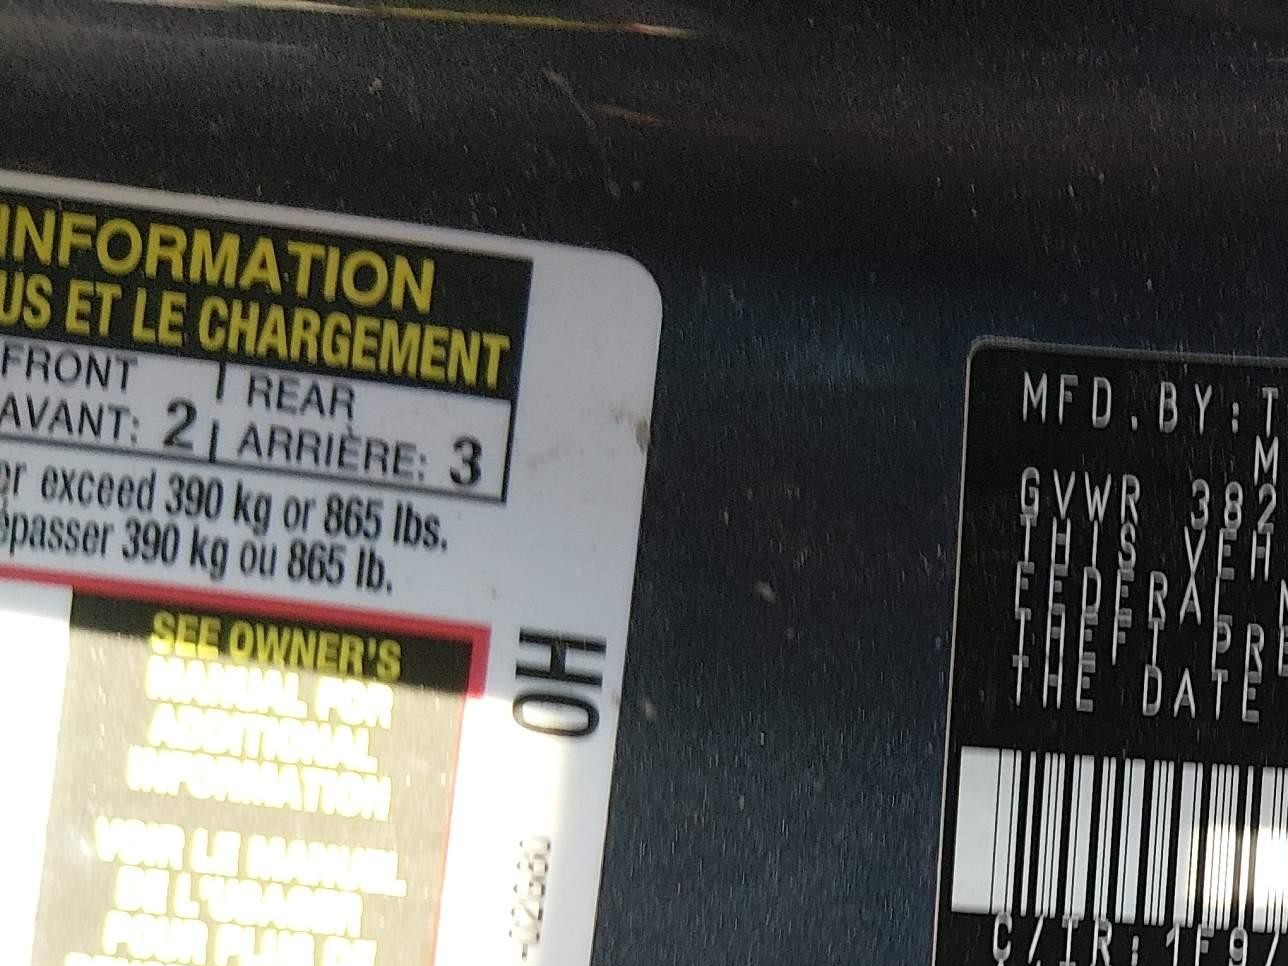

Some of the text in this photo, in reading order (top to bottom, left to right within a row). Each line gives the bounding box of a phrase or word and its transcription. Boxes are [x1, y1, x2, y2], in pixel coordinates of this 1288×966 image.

[65, 278, 122, 337] ET
[132, 286, 188, 347] LE
[199, 295, 511, 391] CHARGEMENT
[3, 341, 355, 423] FRONT REAR
[0, 396, 483, 487] AVANT: 2 ARRIÈRE: 3
[41, 464, 157, 514] exceed
[165, 471, 224, 522] 390
[233, 478, 273, 537] kg
[283, 494, 316, 533] or
[324, 491, 384, 541] 865
[393, 500, 448, 553] lbs.
[1019, 466, 1142, 527] GVWR
[122, 515, 181, 567] 390
[190, 523, 229, 583] kg
[239, 539, 278, 579] ou
[287, 536, 347, 587] 865
[355, 544, 393, 596] lb.
[1018, 514, 1137, 571] THIS
[1014, 561, 1234, 627] FEDERAL
[150, 610, 402, 683] SEE OWNER'S
[1014, 608, 1164, 675] THEFT
[511, 625, 607, 738] OH
[1012, 655, 1095, 712] THE
[1142, 664, 1263, 724] DATE
